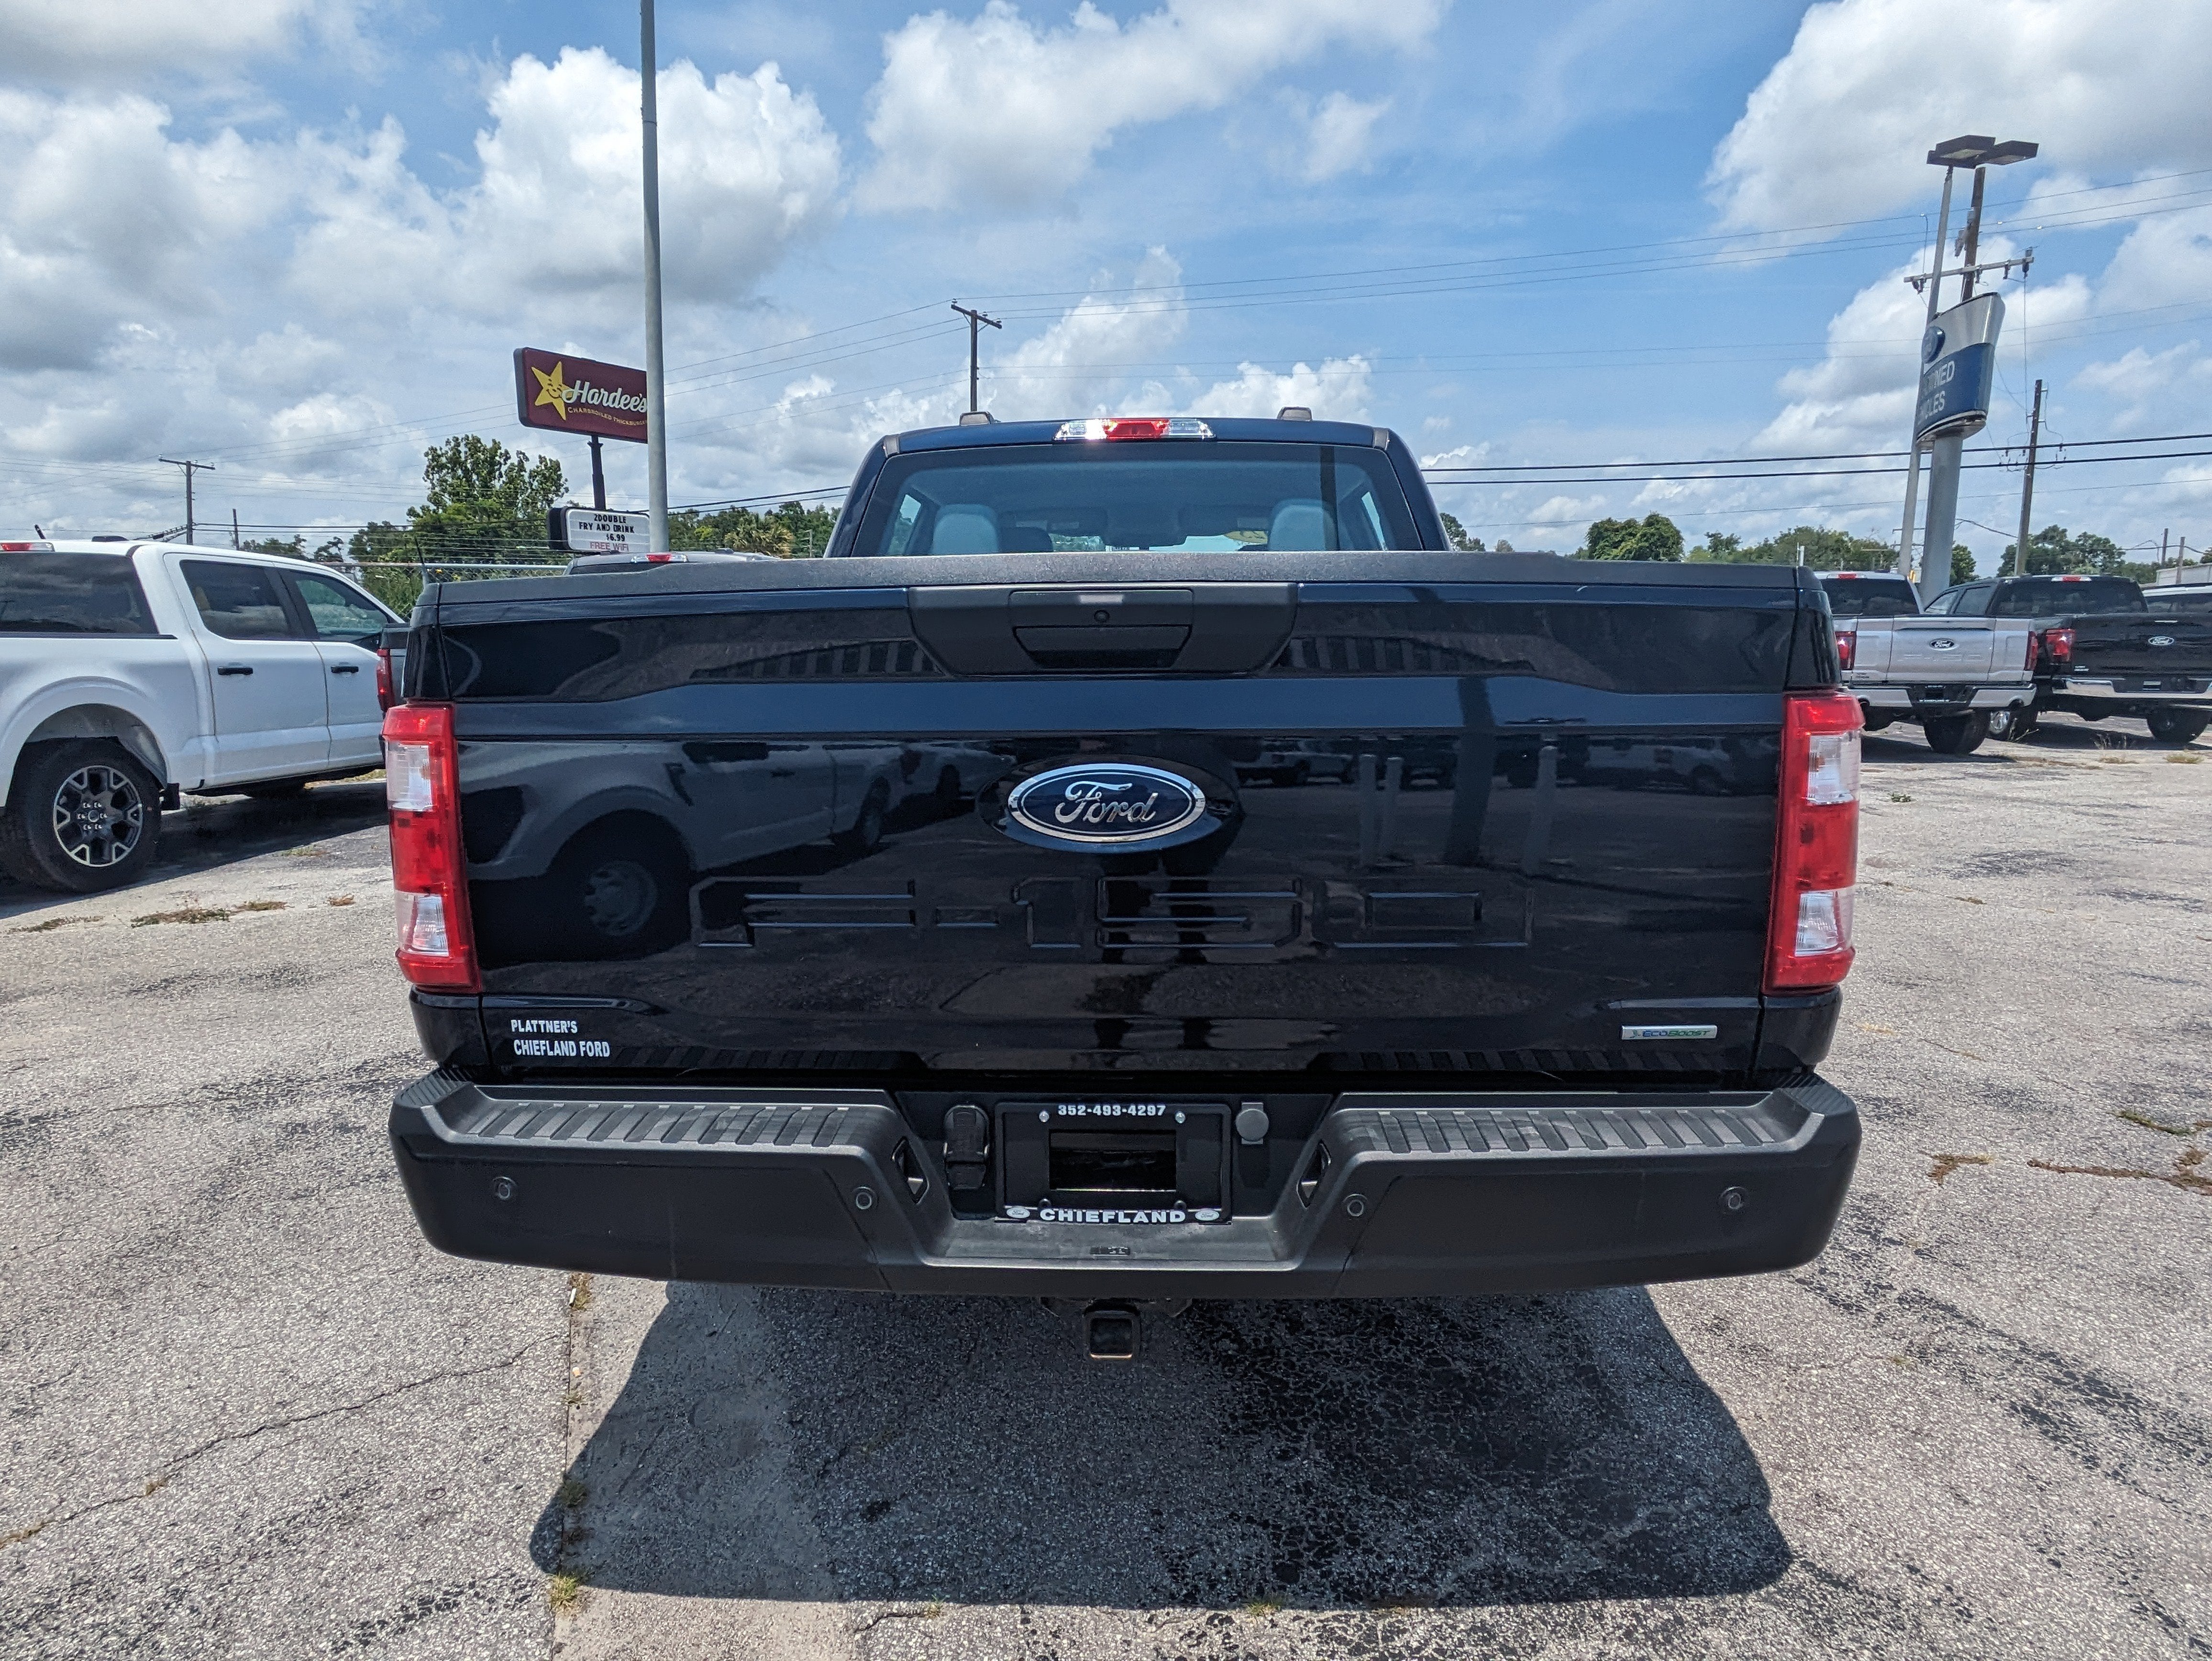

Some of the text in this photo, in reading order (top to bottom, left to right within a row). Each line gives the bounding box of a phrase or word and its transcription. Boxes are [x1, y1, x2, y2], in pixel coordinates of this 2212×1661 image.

[562, 380, 647, 412] Hardee's
[594, 514, 626, 523] 2DOUBLE
[613, 525, 634, 533] DRINK
[1055, 781, 1159, 823] Ford
[511, 1020, 577, 1033] PLATTNER'S
[514, 1040, 610, 1057] CHIEFLAND FORD
[1058, 1105, 1166, 1116] 352-493-4297
[1040, 1209, 1186, 1223] CHIEFLAND
